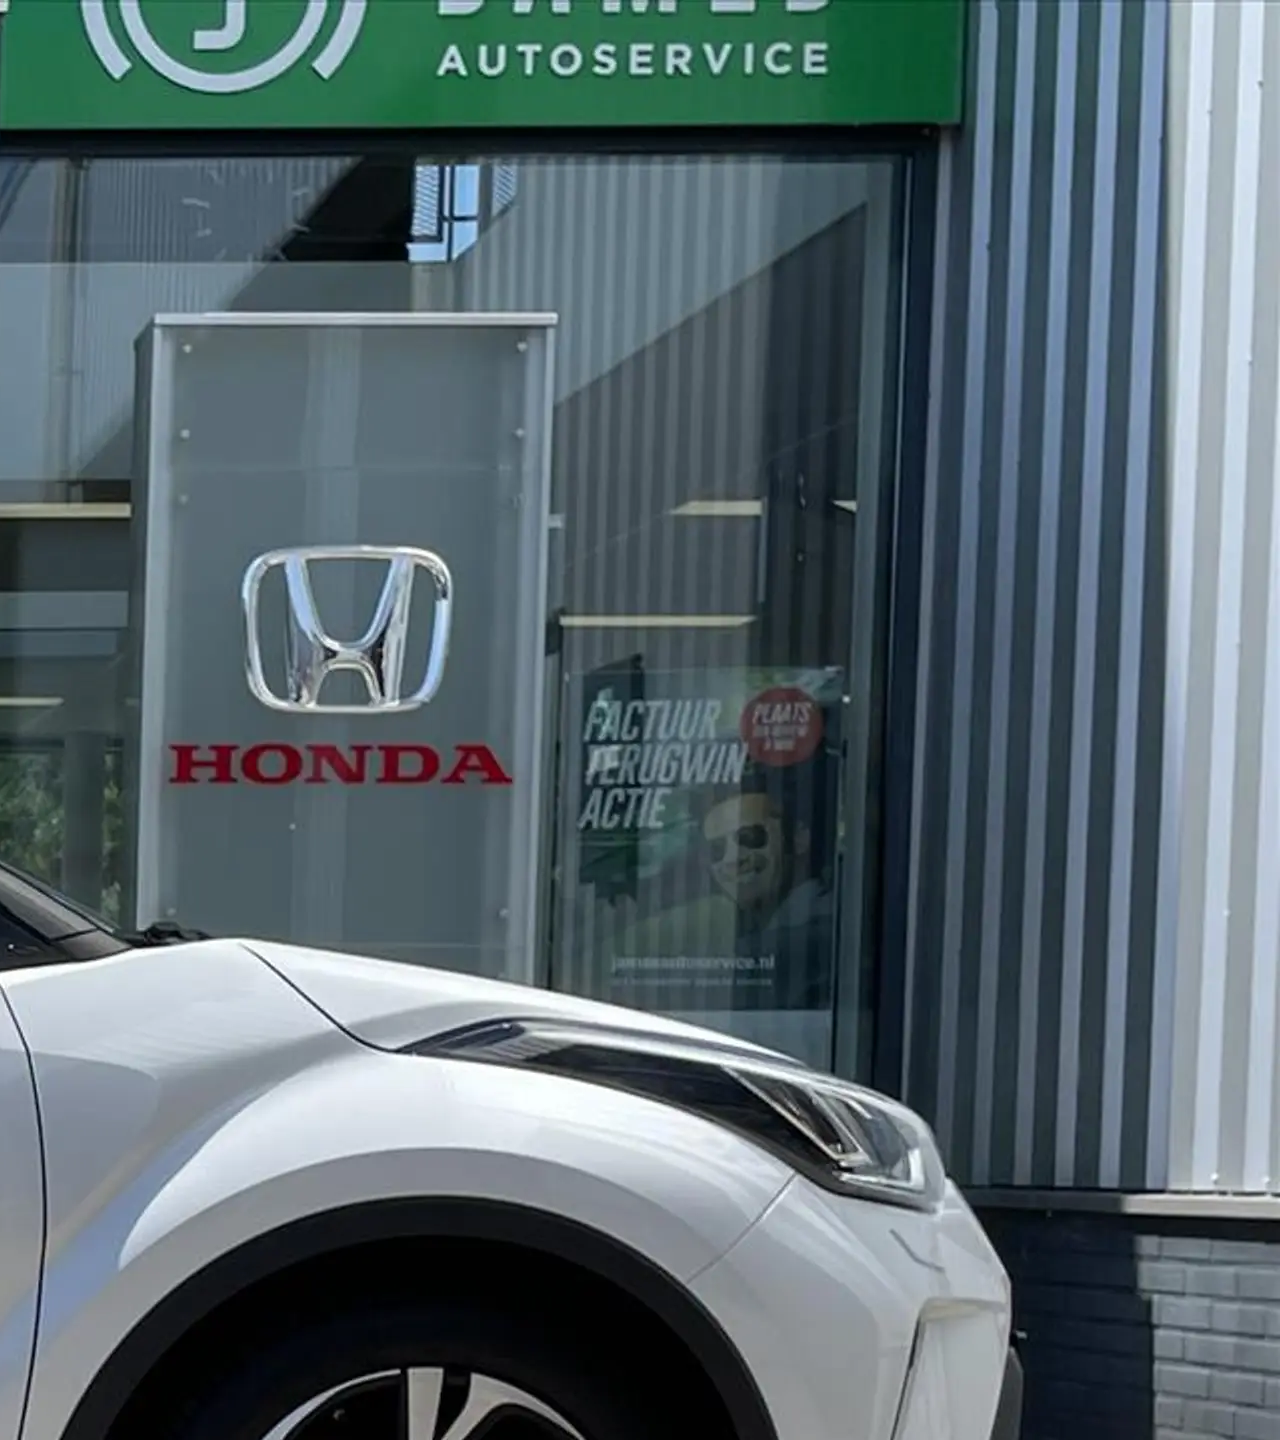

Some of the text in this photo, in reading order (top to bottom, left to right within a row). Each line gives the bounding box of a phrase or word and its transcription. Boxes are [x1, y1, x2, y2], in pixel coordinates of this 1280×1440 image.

[436, 42, 830, 78] AUTOSERVICE
[583, 699, 724, 742] FACTUUR
[168, 743, 513, 784] HONDA
[583, 742, 749, 786] TERUGWIN
[577, 786, 674, 829] ACTIE
